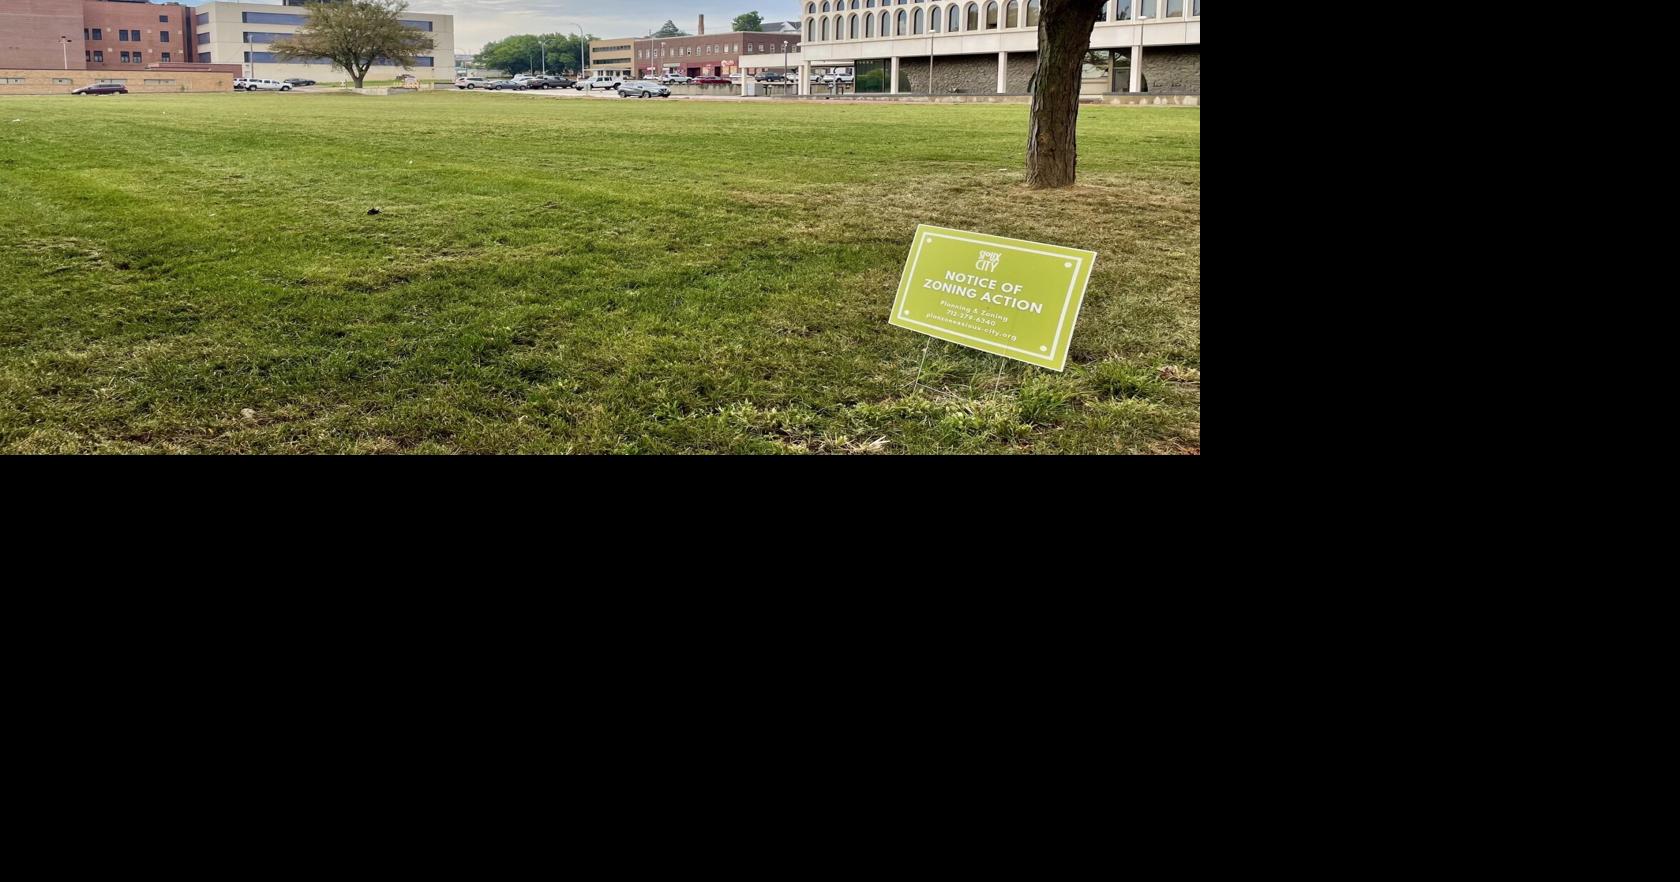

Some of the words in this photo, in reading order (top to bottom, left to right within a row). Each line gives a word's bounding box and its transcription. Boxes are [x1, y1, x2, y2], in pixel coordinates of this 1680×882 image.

[975, 260, 999, 272] CITY
[944, 270, 997, 290] NOTICE
[1001, 282, 1024, 295] OF
[923, 278, 977, 298] ZONING
[980, 292, 1043, 314] ACTION
[940, 300, 971, 314] Planning
[981, 310, 1008, 323] Zoning
